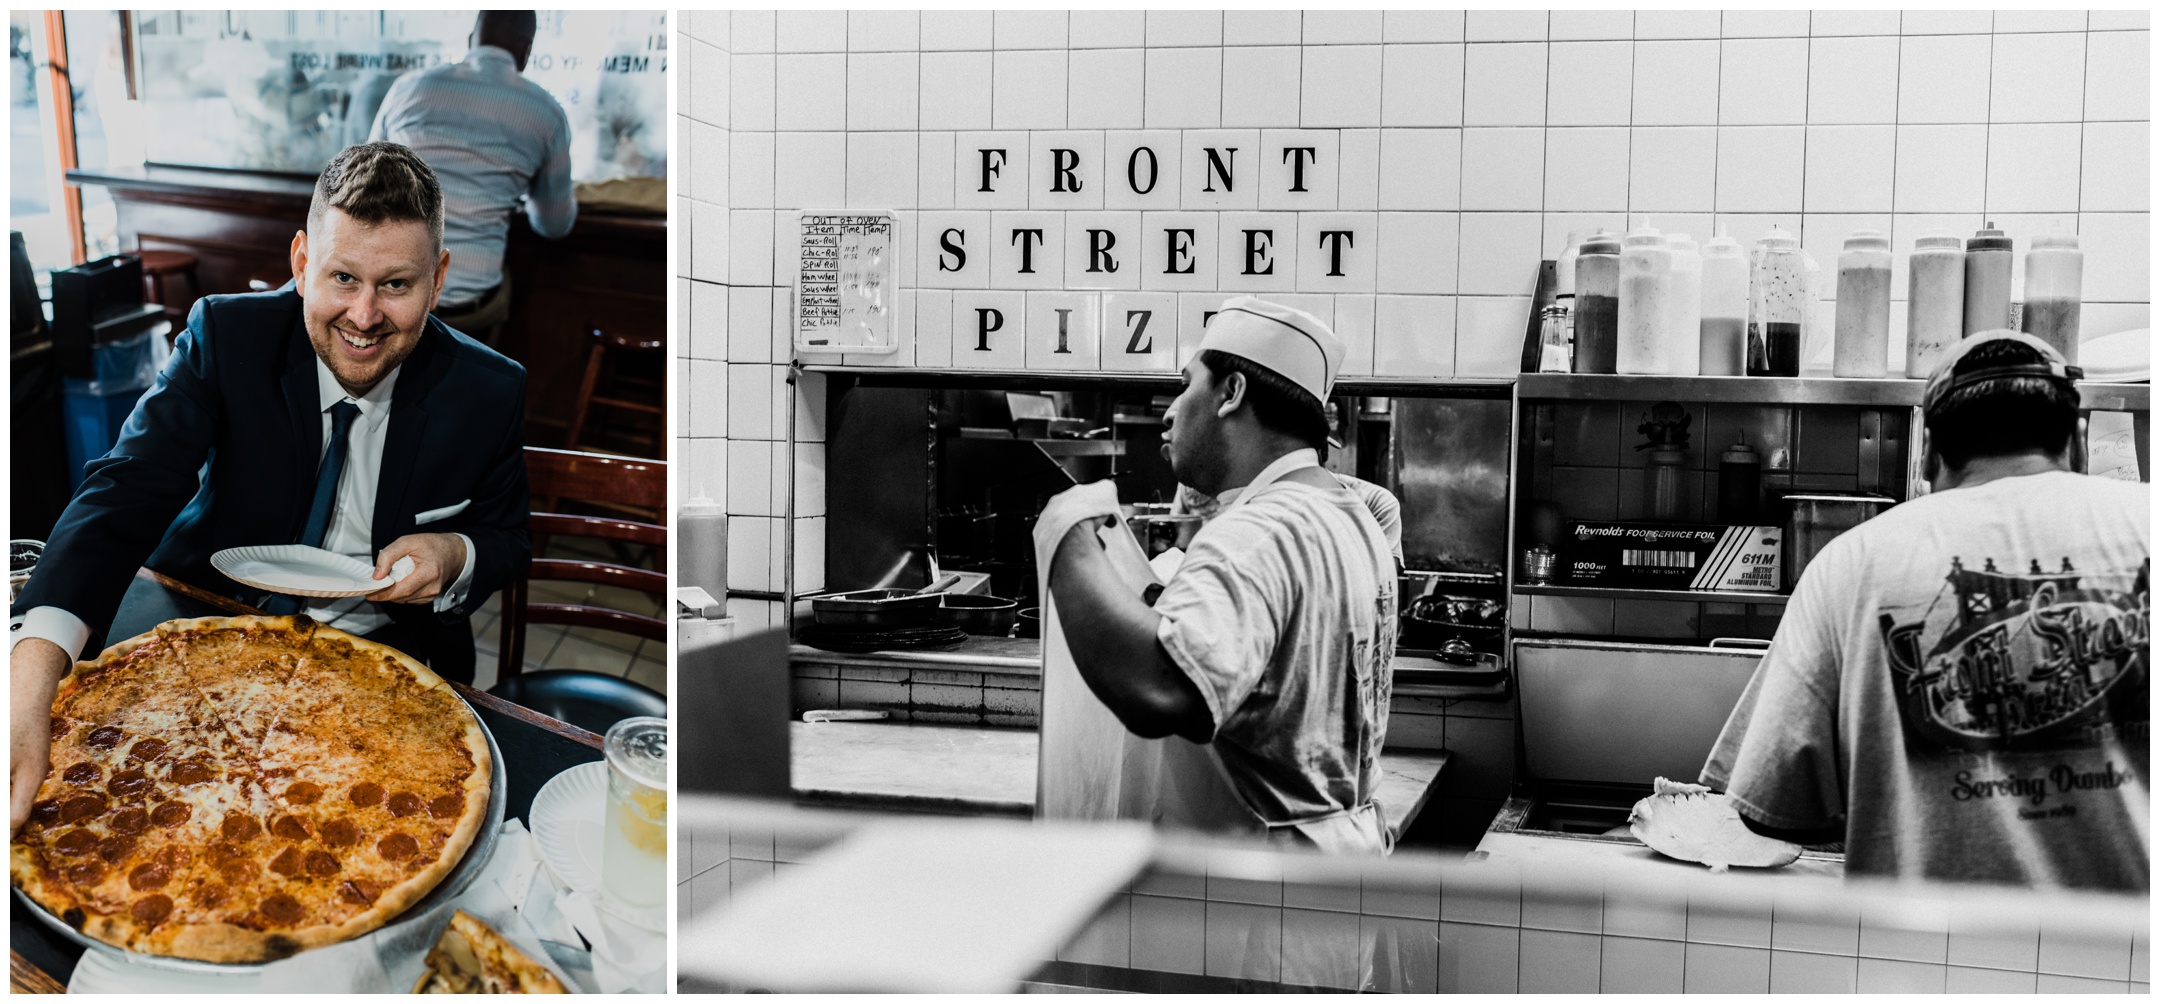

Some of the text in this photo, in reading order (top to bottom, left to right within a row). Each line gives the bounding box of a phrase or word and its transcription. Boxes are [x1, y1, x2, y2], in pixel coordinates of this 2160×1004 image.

[977, 146, 1316, 194] FRONT
[805, 225, 886, 235] Item Time Temp
[938, 228, 1354, 277] STREET
[802, 307, 820, 317] Beef
[974, 308, 1218, 354] PIZ
[1575, 524, 1624, 536] Reynolds
[1694, 531, 1715, 540] FOIL
[1741, 553, 1776, 565] 611M
[1573, 561, 1596, 570] 1000
[1741, 572, 1772, 580] STANDARD
[1726, 578, 1772, 587] ALUMINUM FOIL
[1951, 769, 2047, 806] Serving
